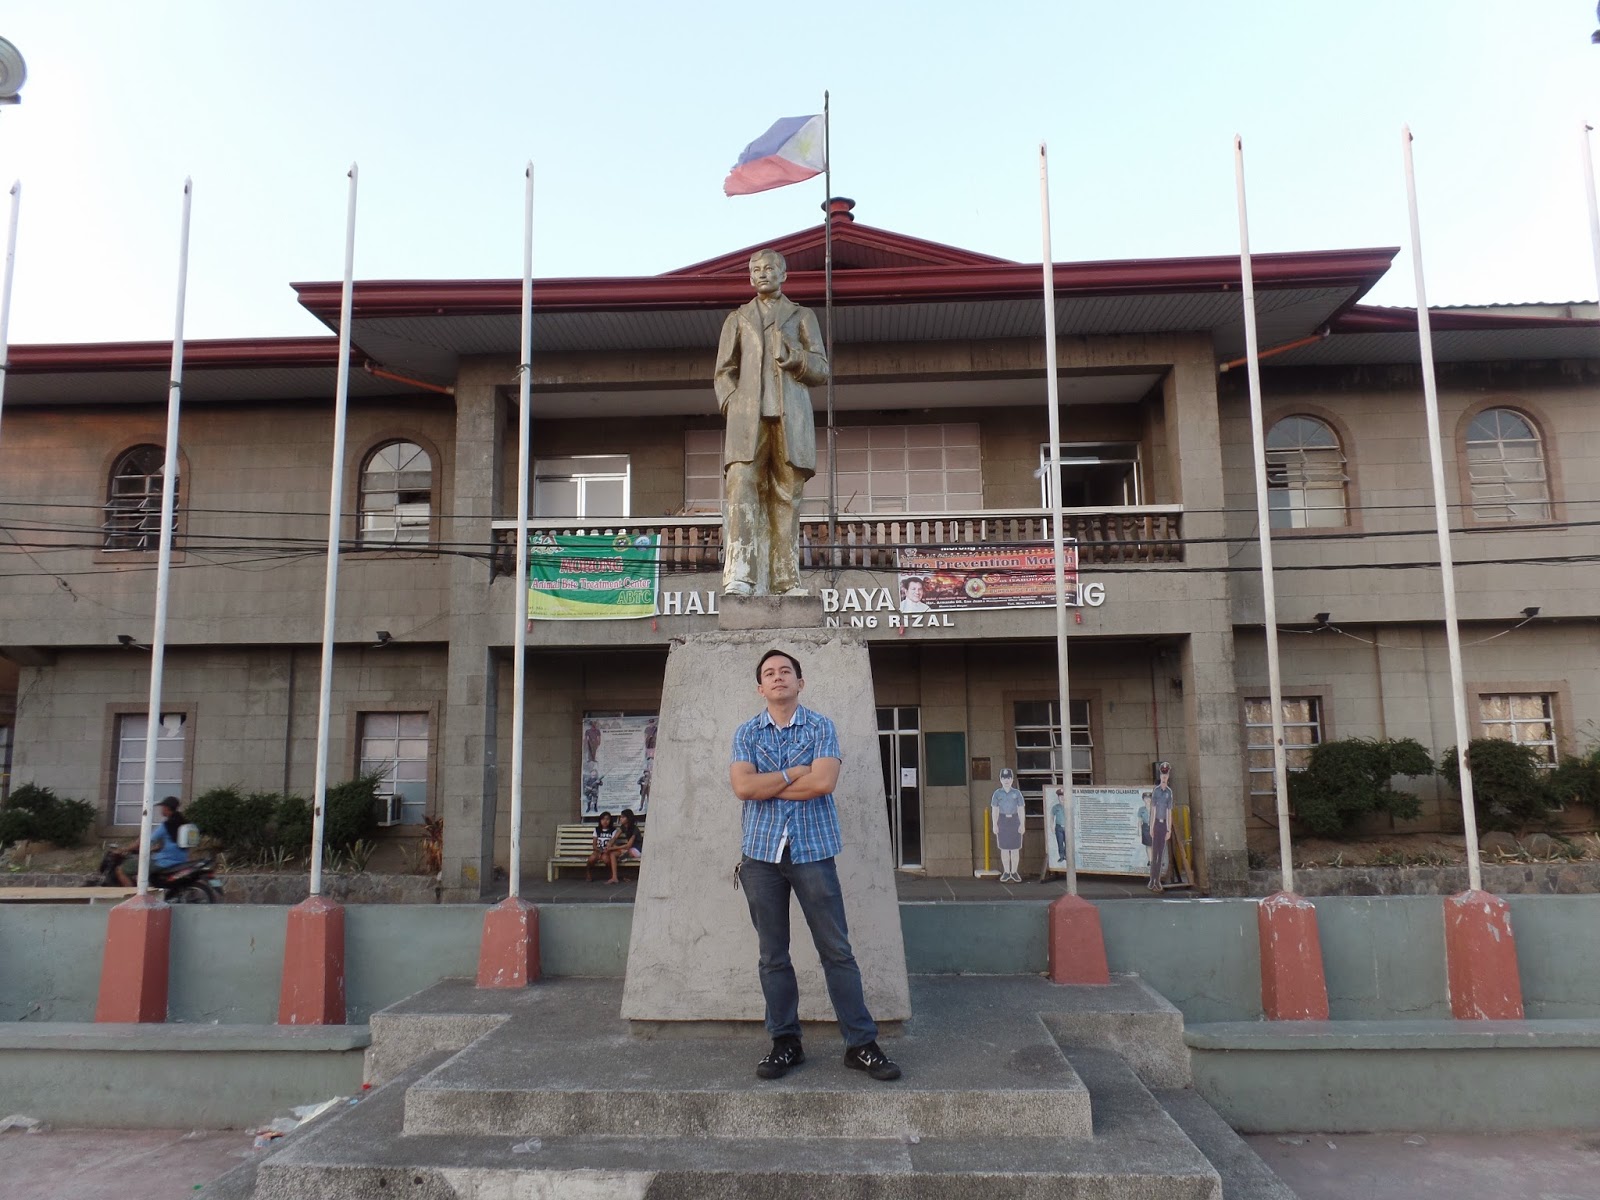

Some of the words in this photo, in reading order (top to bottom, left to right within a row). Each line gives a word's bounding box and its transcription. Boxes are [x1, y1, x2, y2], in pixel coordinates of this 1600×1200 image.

[935, 558, 1020, 569] Prevention
[1026, 555, 1074, 565] Monh
[531, 578, 560, 589] Animal
[561, 578, 579, 589] Bite
[580, 578, 622, 589] Treatment
[623, 577, 651, 589] Center
[617, 590, 651, 604] ABTC
[820, 587, 900, 612] BAYA
[850, 615, 878, 628] NG
[888, 613, 955, 628] RIZAL
